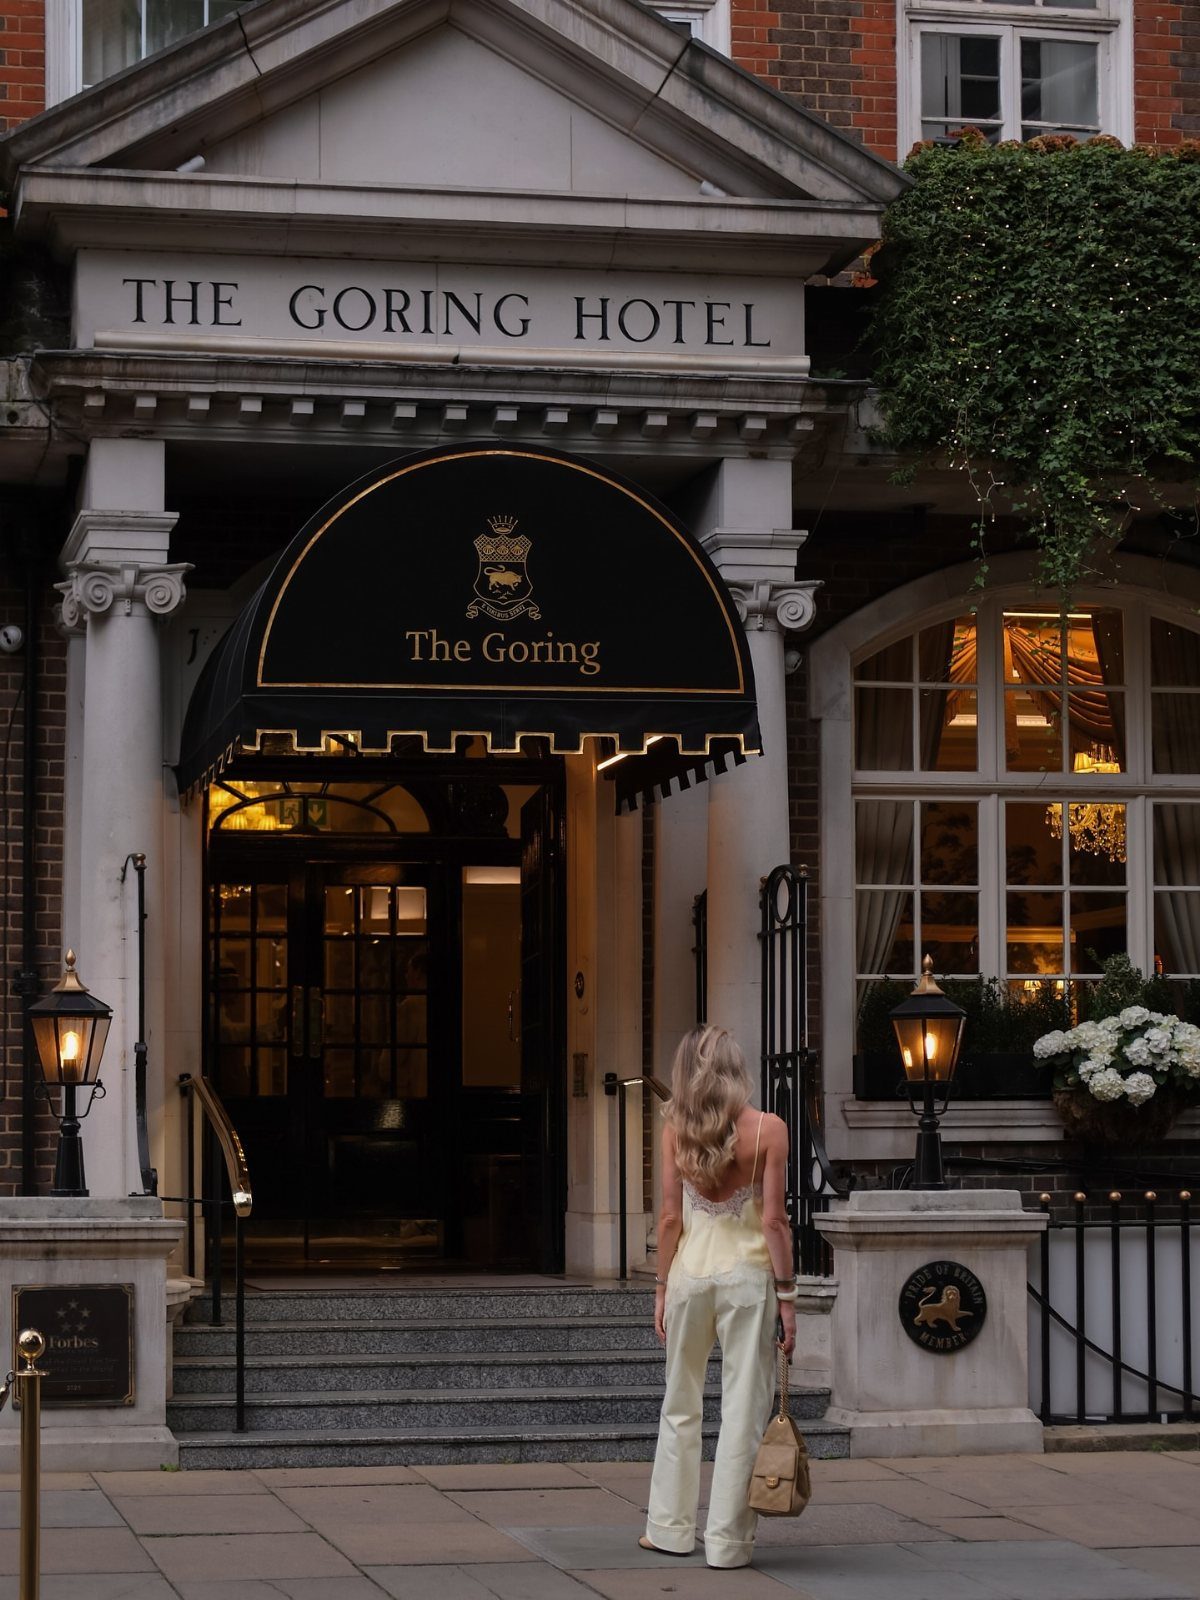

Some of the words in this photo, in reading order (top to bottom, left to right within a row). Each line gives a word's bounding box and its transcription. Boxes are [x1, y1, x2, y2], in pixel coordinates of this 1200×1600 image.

[123, 279, 241, 326] THE
[289, 285, 531, 338] GORING
[574, 297, 771, 347] HOTEL
[406, 629, 471, 661] The
[483, 632, 600, 674] Goring
[905, 1270, 932, 1298] PRIDE
[936, 1264, 950, 1276] OF
[954, 1267, 983, 1304] BRITAIN
[48, 1335, 99, 1349] Forbes
[919, 1332, 967, 1349] MEMBER
